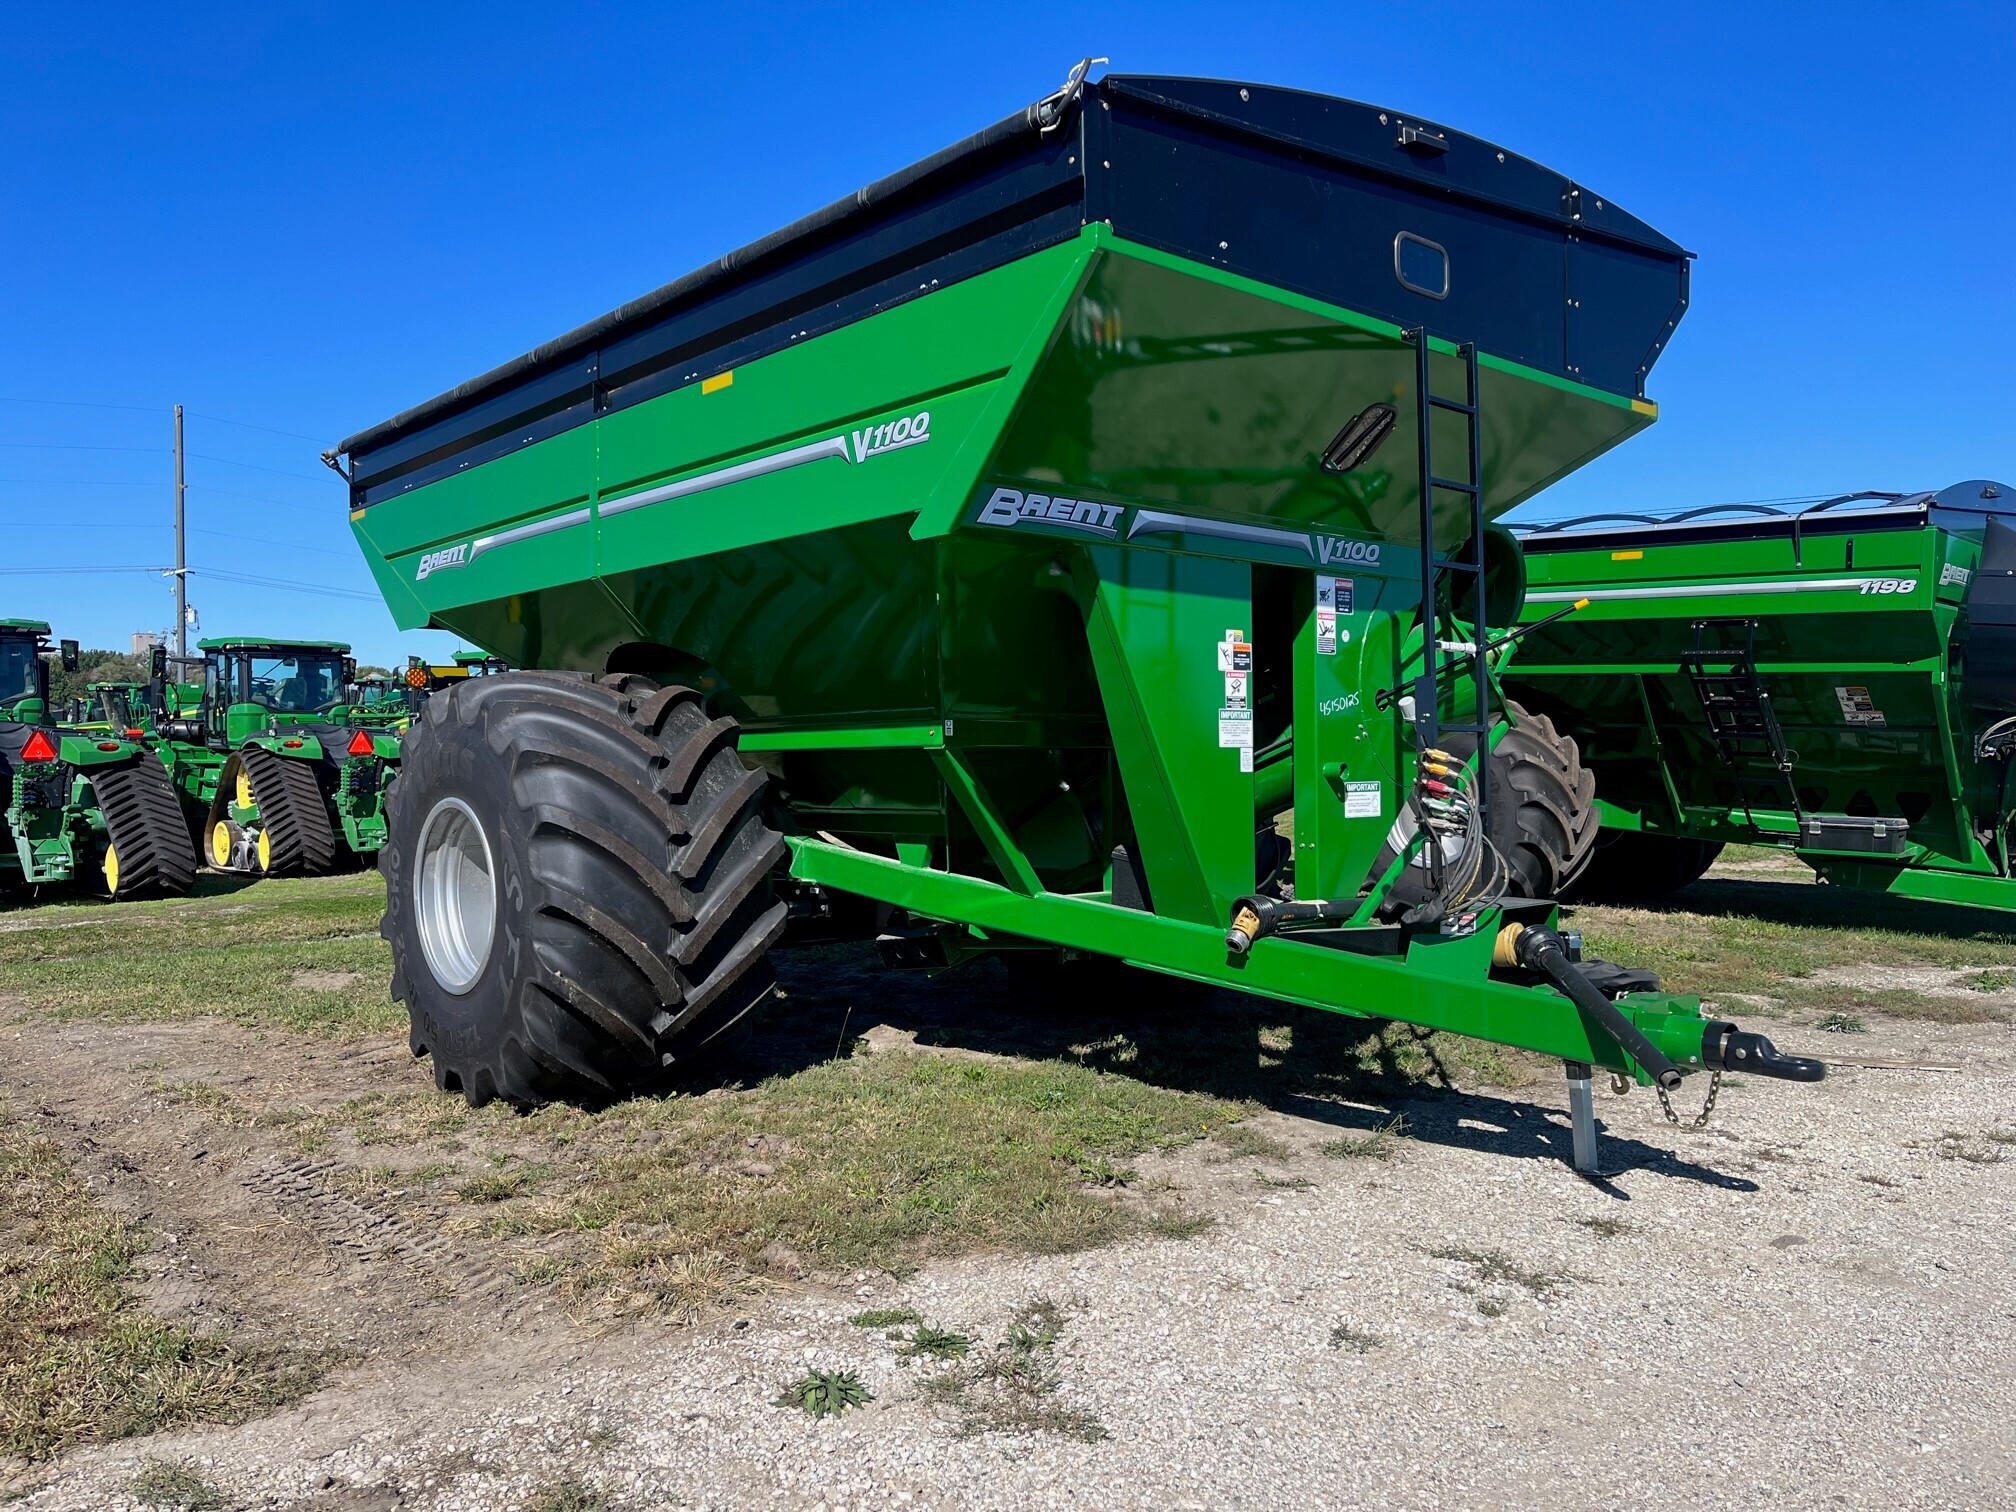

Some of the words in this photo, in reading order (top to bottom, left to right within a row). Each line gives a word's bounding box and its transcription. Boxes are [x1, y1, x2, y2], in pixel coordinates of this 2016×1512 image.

[851, 411, 930, 463] V1100
[976, 487, 1125, 532] BRENT
[1315, 535, 1381, 565] V1100
[415, 543, 468, 582] BRENT
[1859, 579, 1918, 595] 1198
[1220, 711, 1251, 720] IMPORTANT
[1346, 783, 1379, 792] IMPORTANT
[389, 847, 402, 917] CHO
